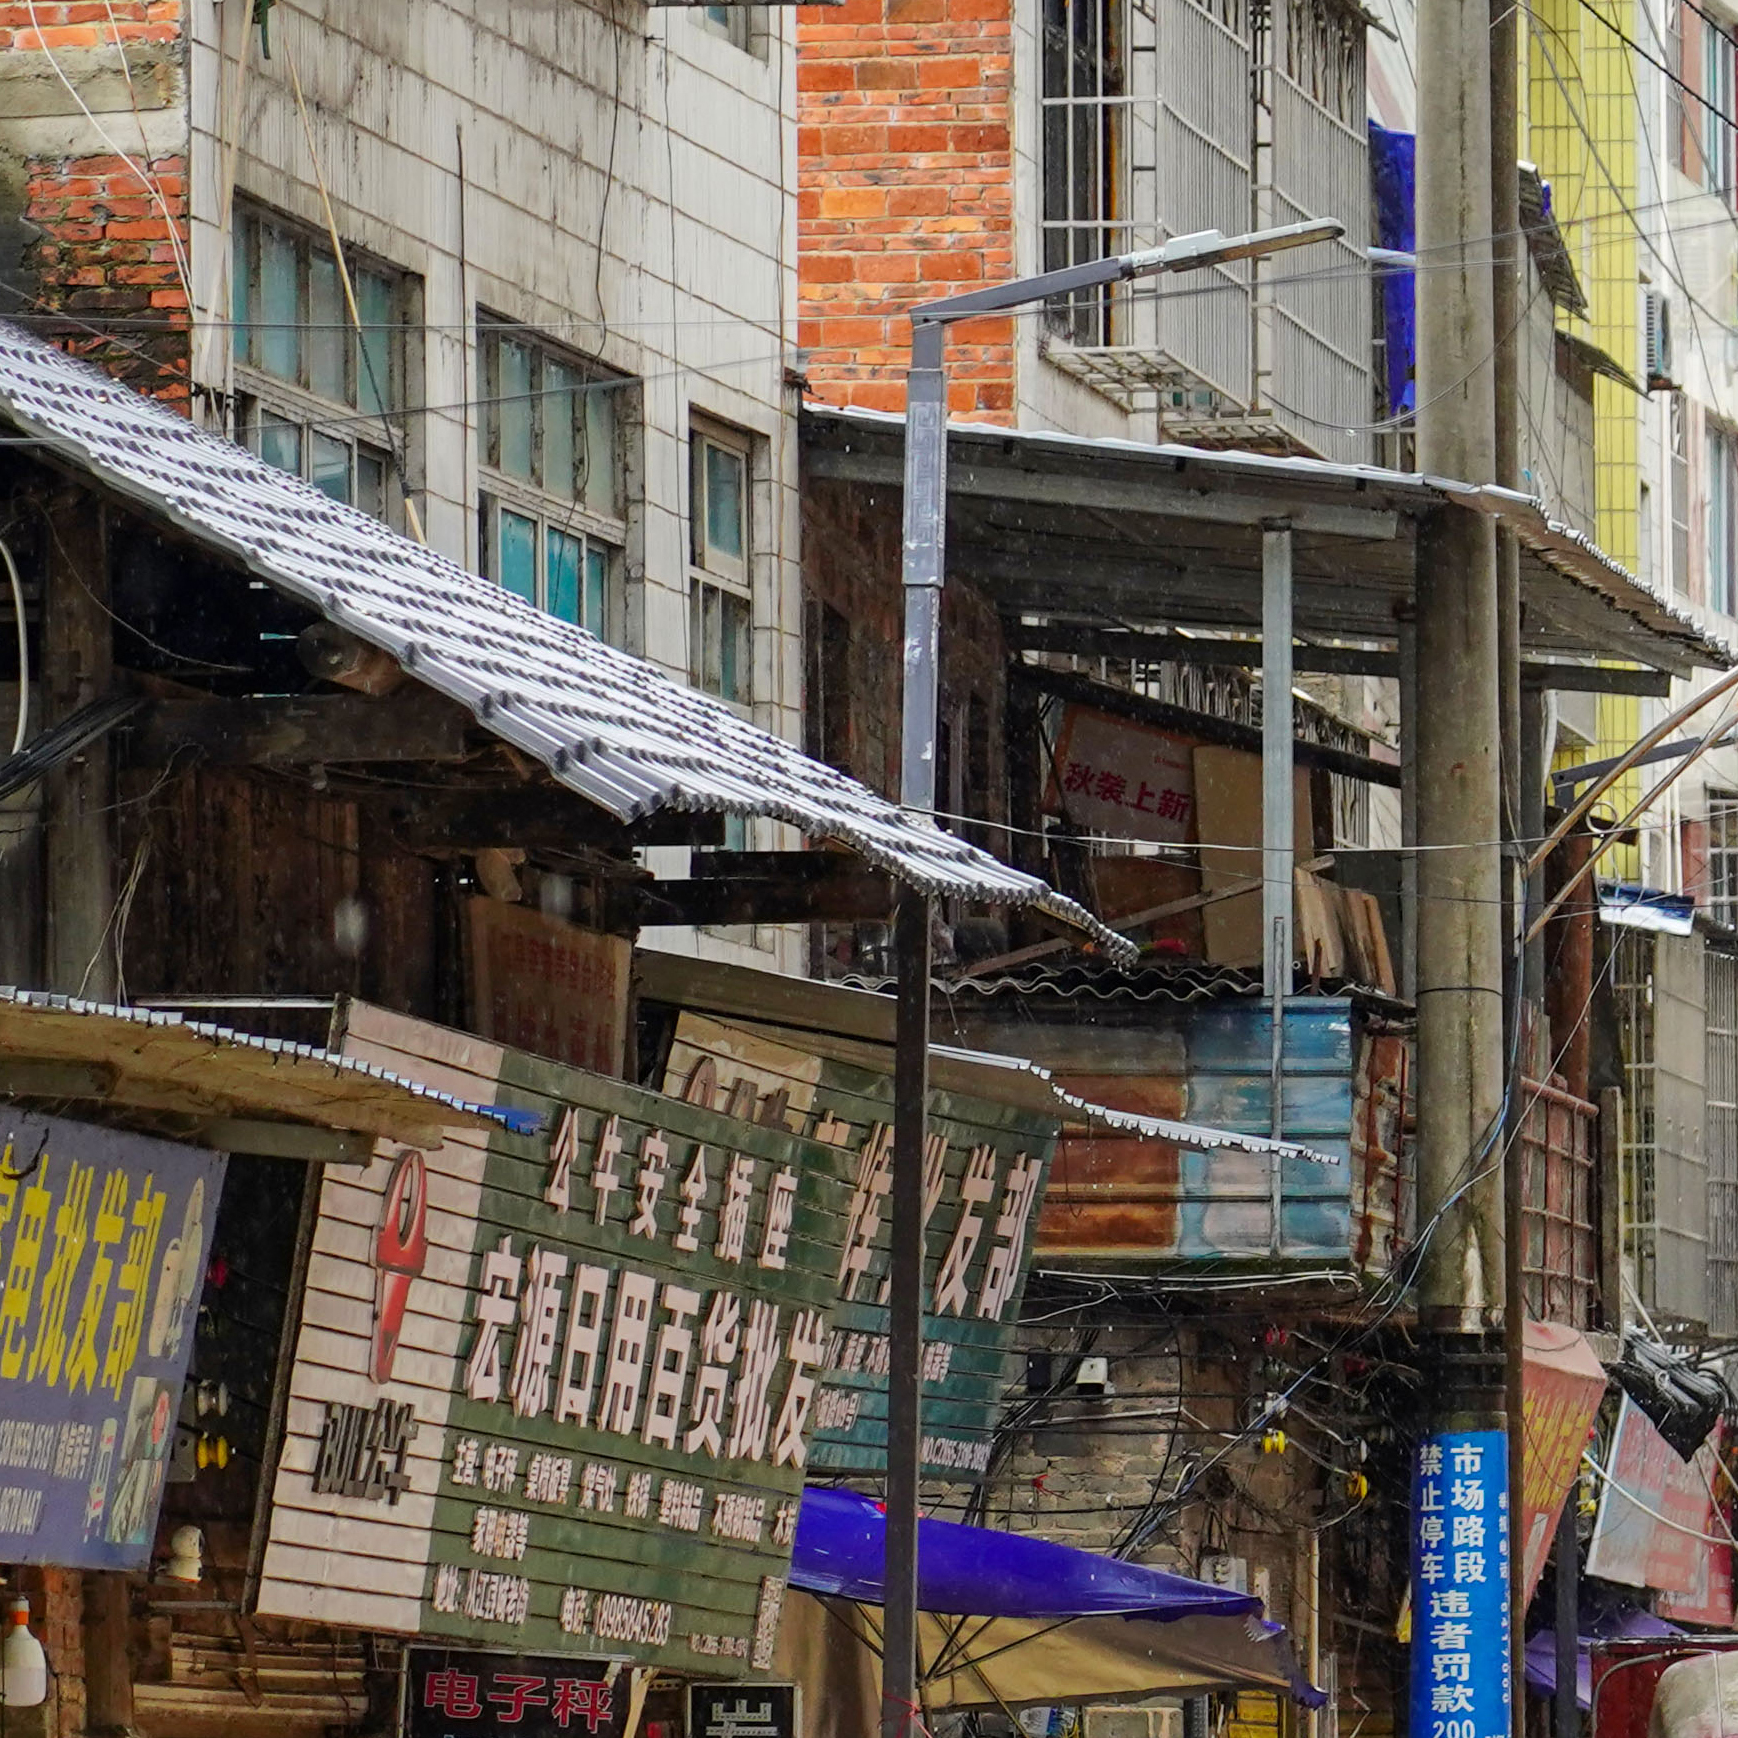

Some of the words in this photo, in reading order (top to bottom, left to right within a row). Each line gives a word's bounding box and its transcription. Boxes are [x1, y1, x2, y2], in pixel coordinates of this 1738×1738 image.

[1064, 762, 1192, 824] 秋装上新
[544, 1105, 799, 1271] 公牛安全插座
[465, 1233, 825, 1470] 宏源日用百货批发
[658, 1476, 705, 1533] 塑料制品
[710, 1491, 767, 1544] 不锈钢制品
[1420, 1445, 1445, 1585] 禁止停车
[1450, 1442, 1487, 1584] 市场路段
[593, 1593, 673, 1647] 18985845283
[423, 1667, 613, 1735] 电子秤
